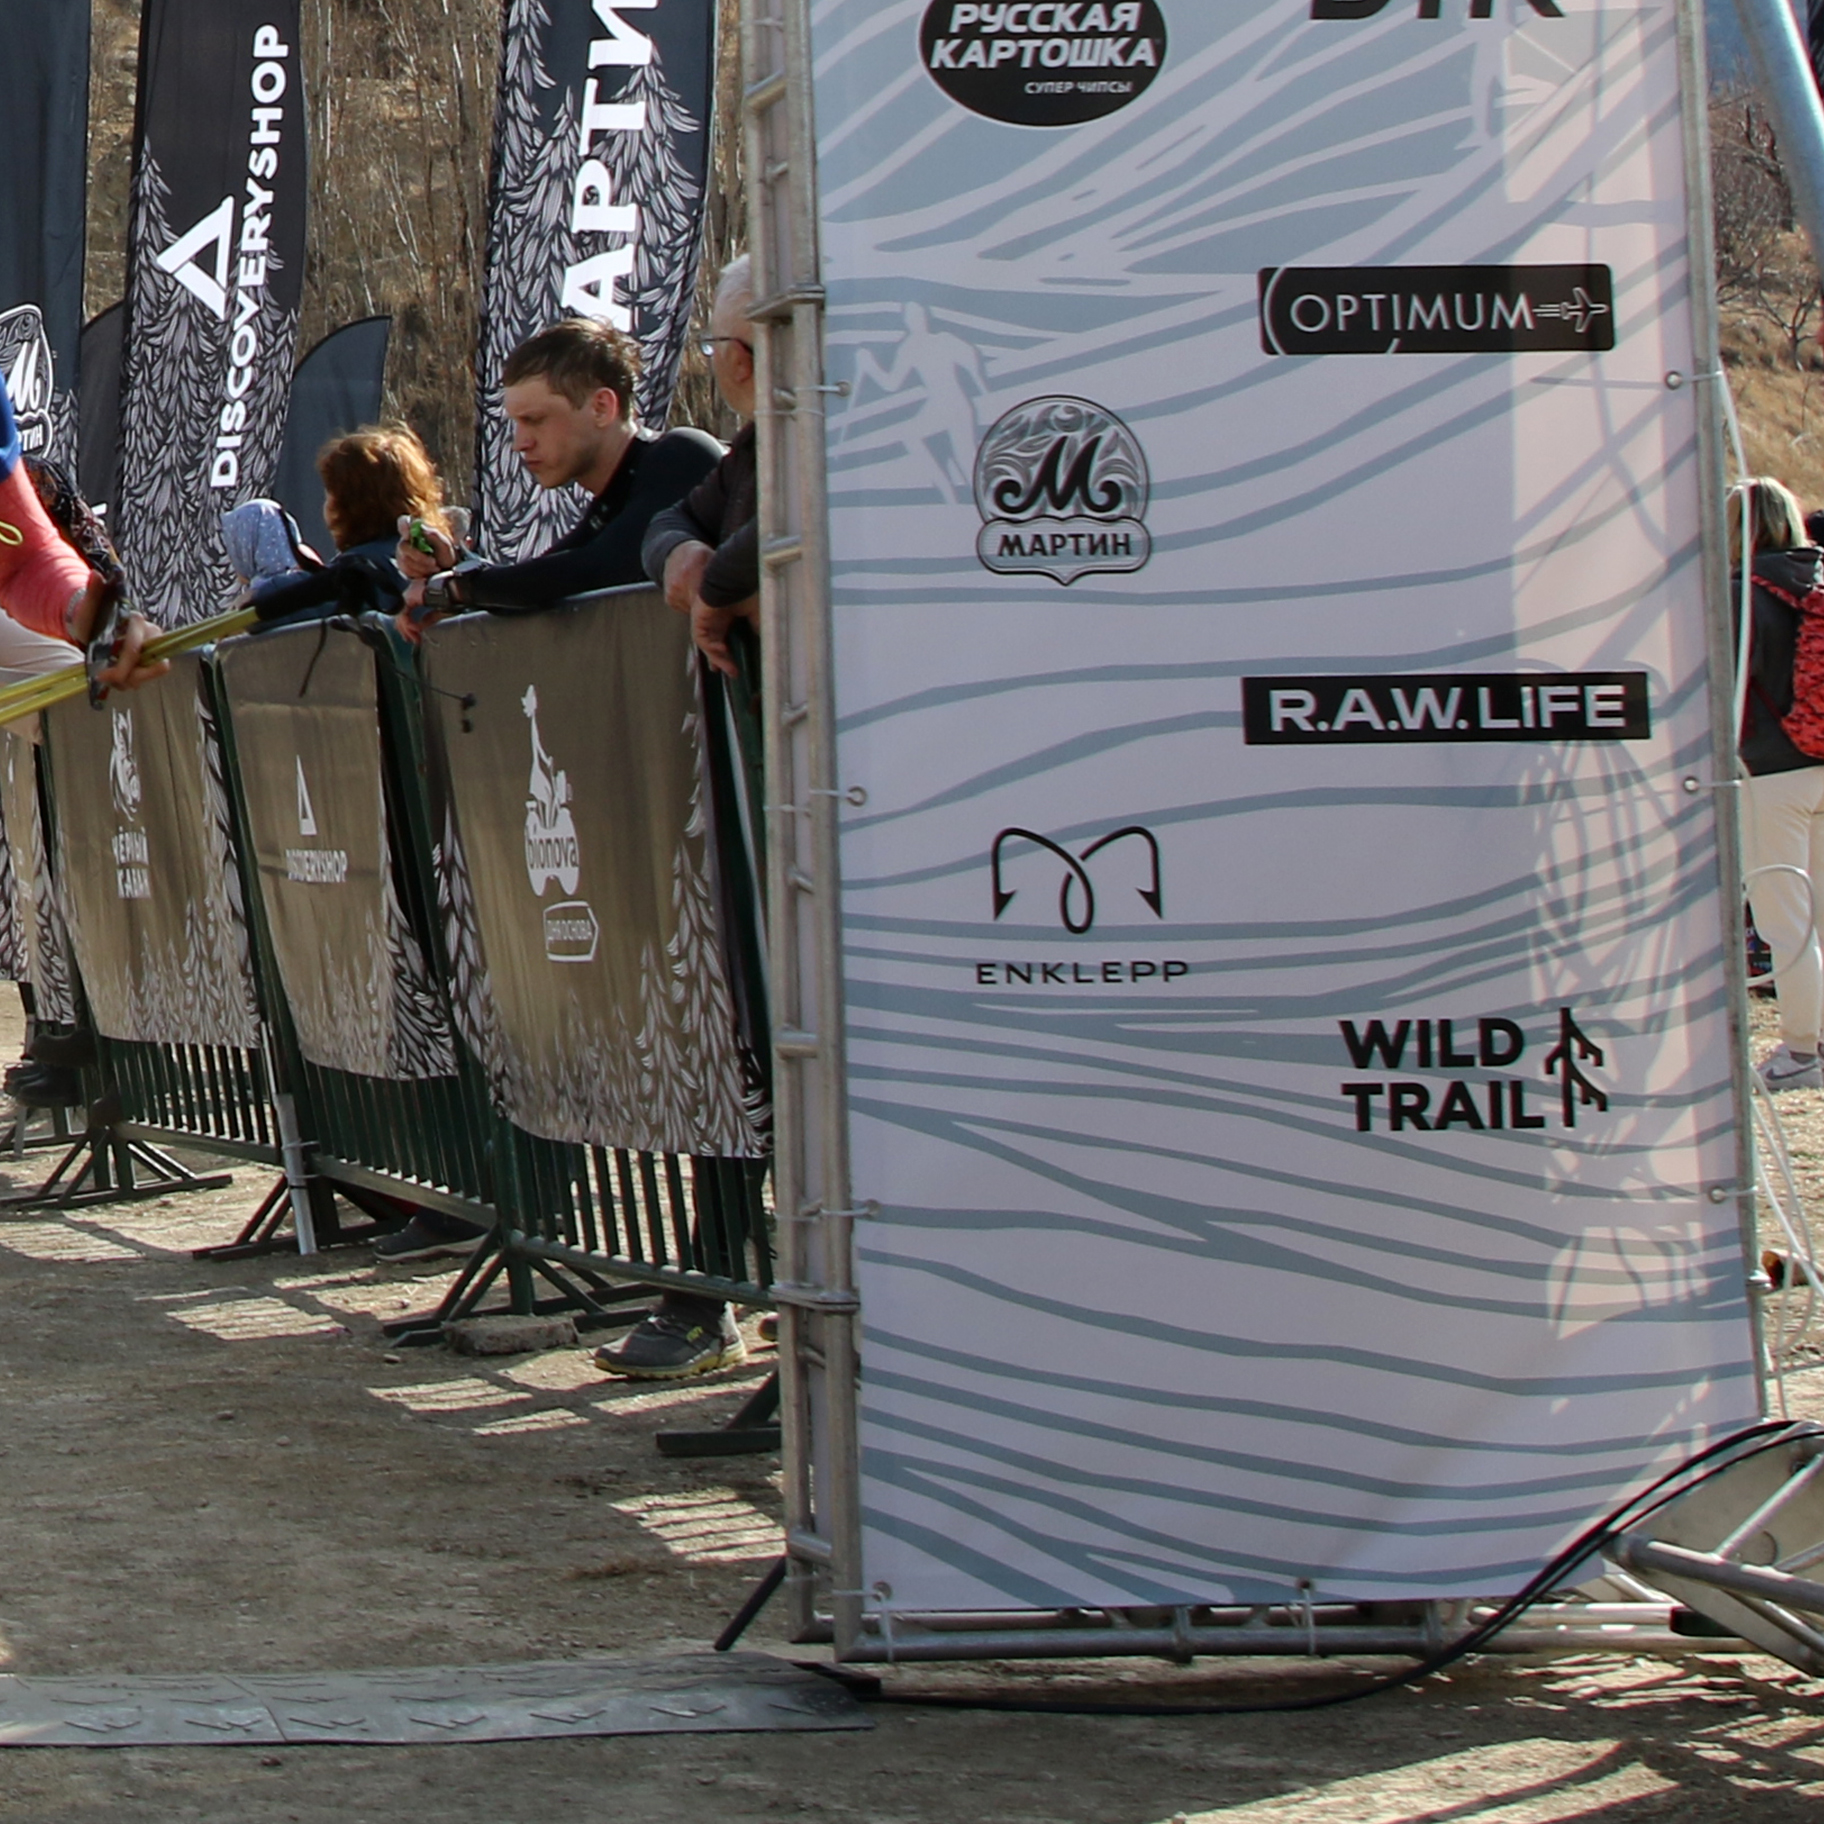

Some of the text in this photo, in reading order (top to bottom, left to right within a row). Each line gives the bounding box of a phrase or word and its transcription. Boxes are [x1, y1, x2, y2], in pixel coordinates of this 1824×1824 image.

[949, 1, 1142, 34] РУССКАЯ
[929, 37, 1157, 70] КАРТОШКА
[1024, 80, 1132, 95] СУПЕР ЧИПСЫ
[209, 22, 291, 489] DISCOVERYSHOP
[1289, 292, 1535, 333] OPTIMUM
[996, 531, 1133, 558] МАРТИН
[975, 959, 1190, 986] ENKLEPP
[1337, 1016, 1526, 1070] WILD
[1341, 1079, 1547, 1133] TRAIL
